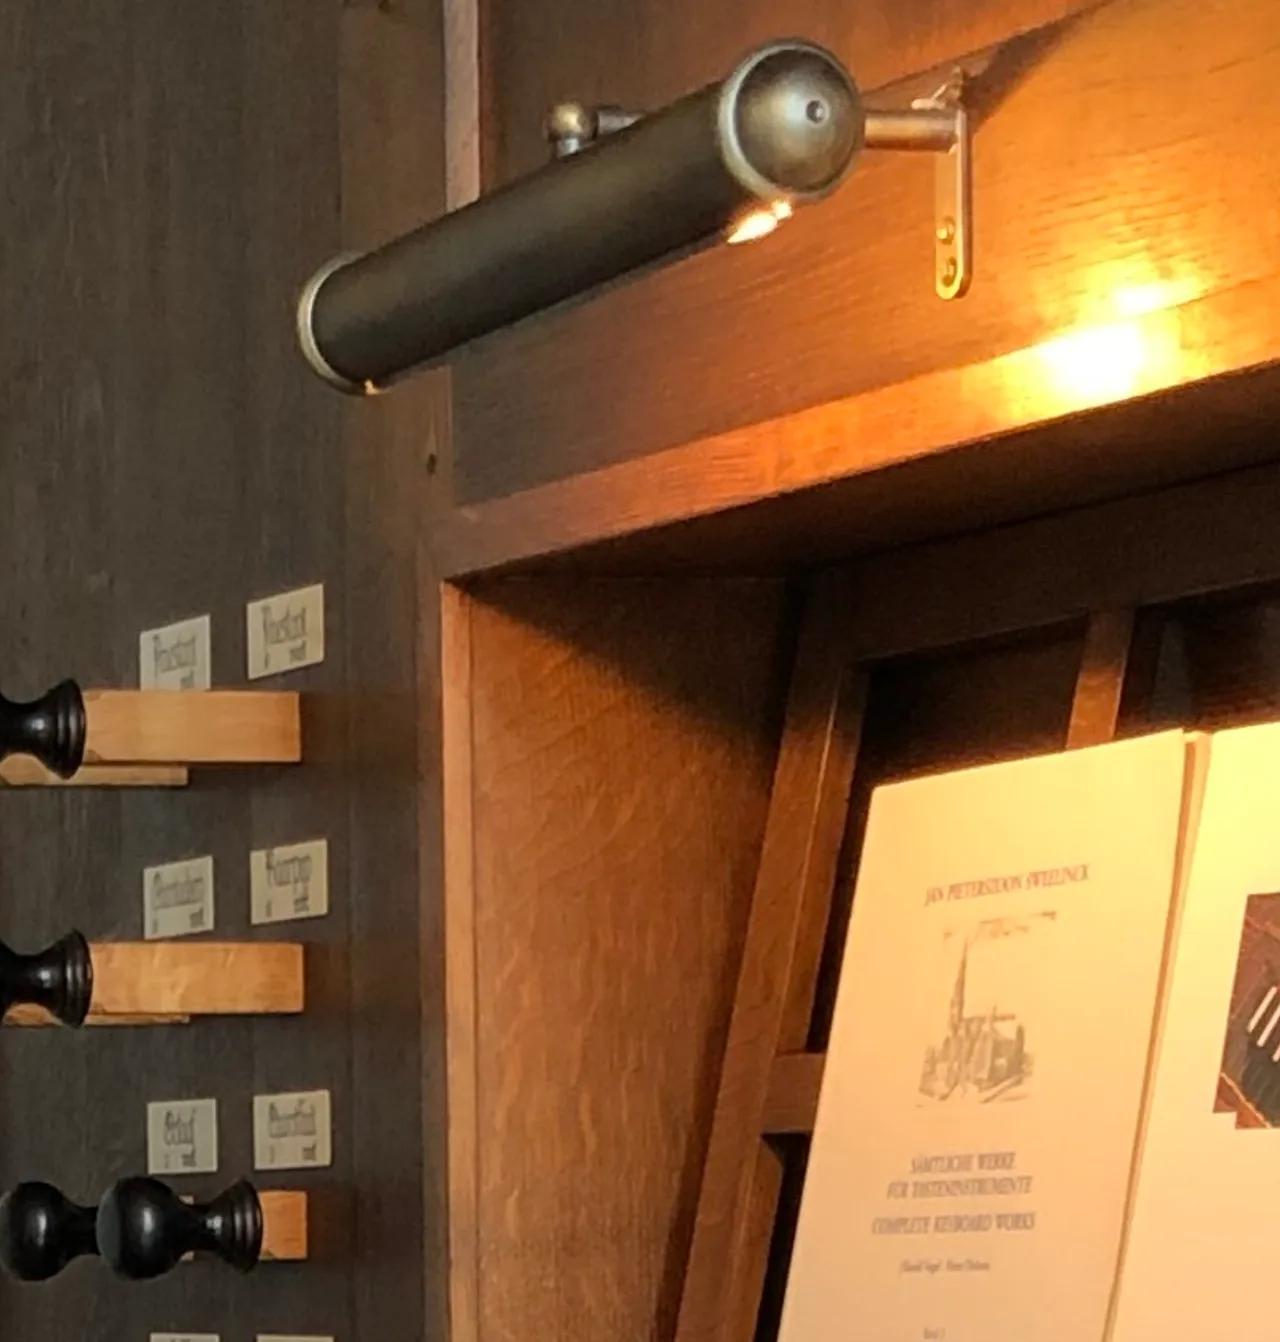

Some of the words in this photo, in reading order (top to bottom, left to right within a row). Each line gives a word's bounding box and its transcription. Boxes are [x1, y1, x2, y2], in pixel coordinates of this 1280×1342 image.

[871, 1216, 930, 1235] COMPLETE
[933, 1214, 992, 1233] KEYBOARD
[994, 1212, 1036, 1231] WORKS
